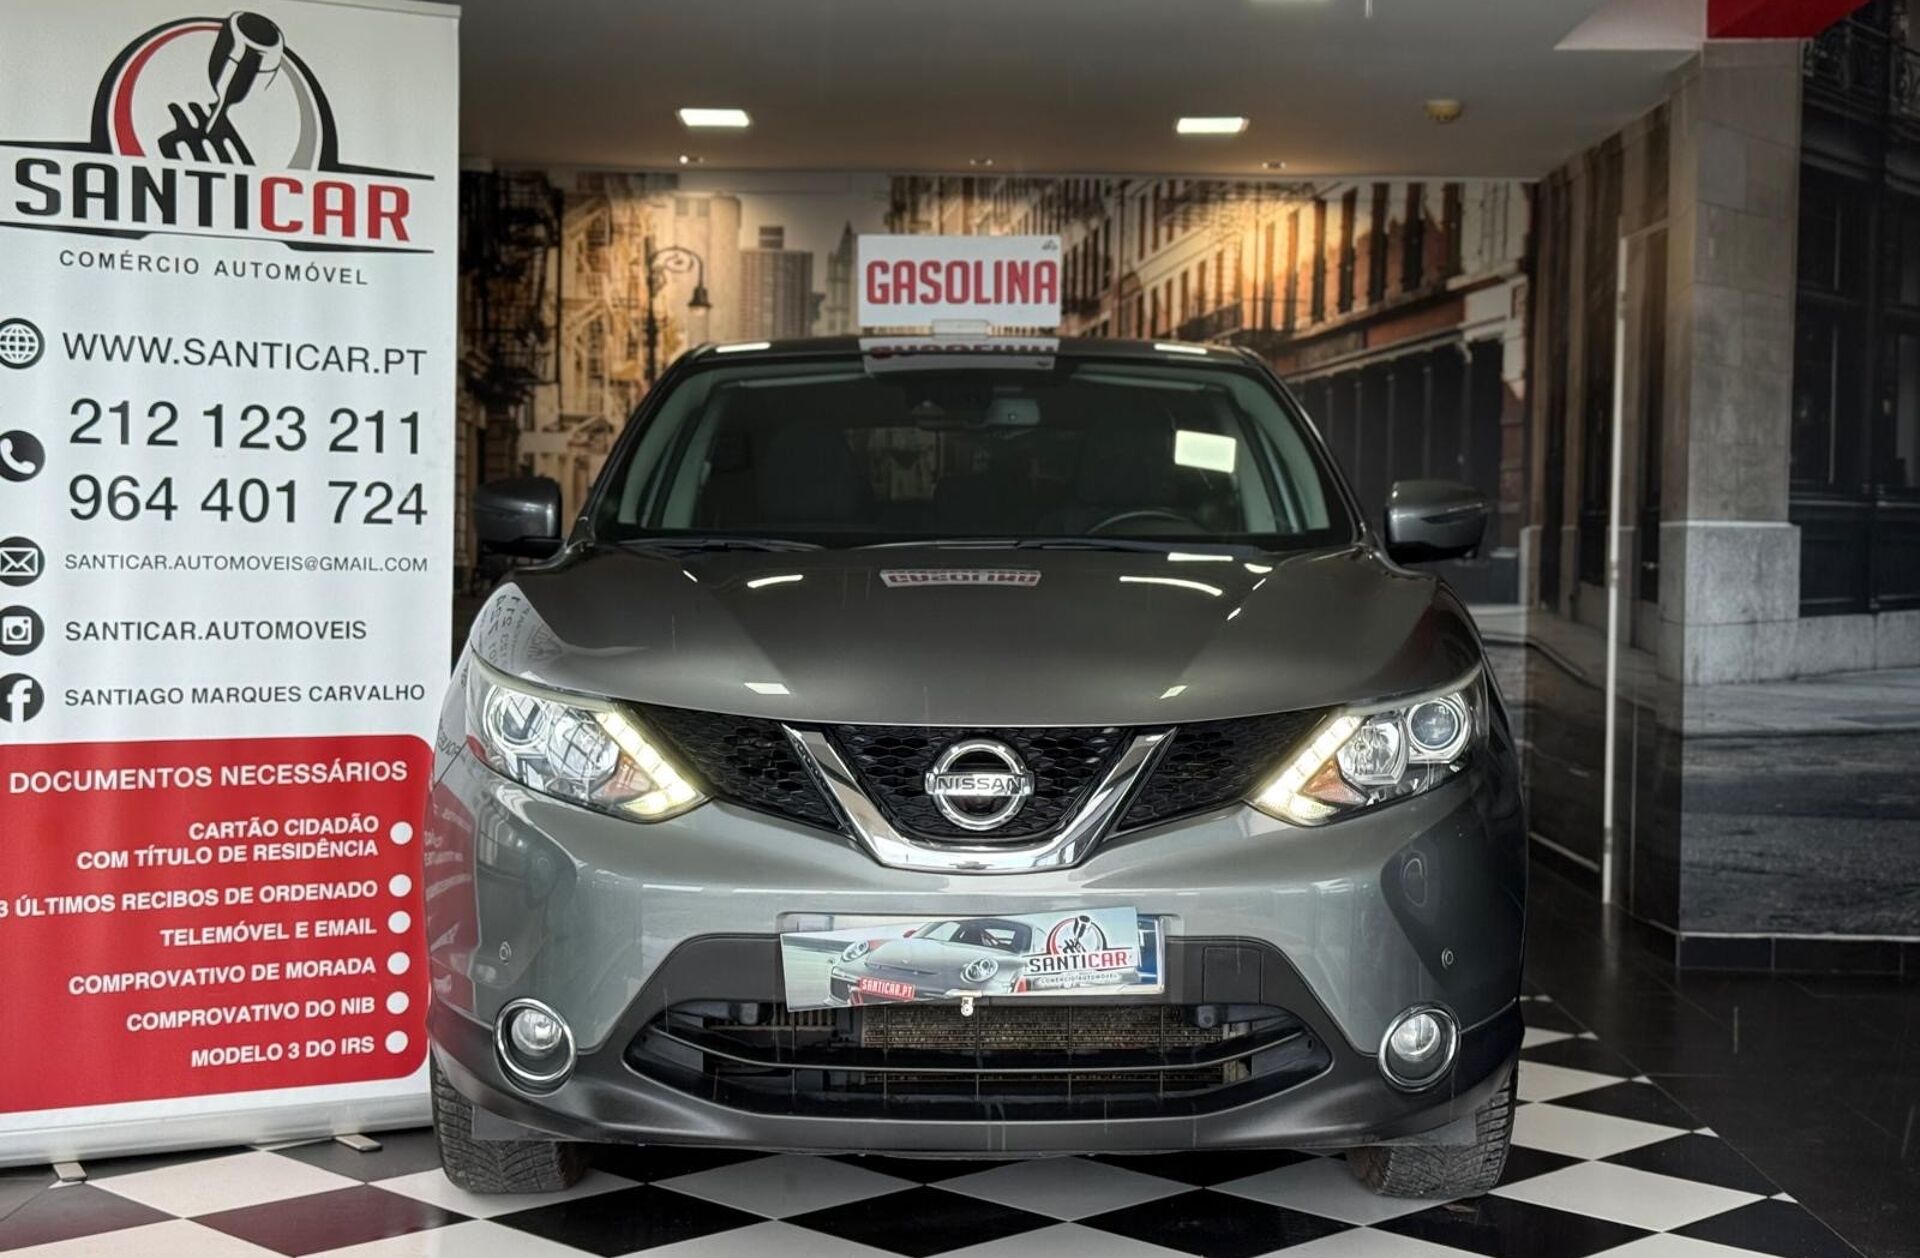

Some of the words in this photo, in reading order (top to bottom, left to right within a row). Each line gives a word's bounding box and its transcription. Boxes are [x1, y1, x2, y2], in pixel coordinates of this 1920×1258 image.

[15, 157, 410, 241] SANTICAR
[60, 250, 199, 274] COMÉRCIO
[214, 260, 367, 285] AUTOMÓVEL
[866, 260, 1057, 305] GASOLINA
[63, 333, 427, 375] WWW.SANTICAR.PT
[70, 398, 177, 446] 212
[204, 404, 306, 451] 123
[329, 408, 418, 454] 211
[70, 474, 178, 520] 964
[201, 478, 295, 523] 401
[329, 481, 427, 525] 724
[65, 554, 427, 571] SANTICAR.AUTOMOVEIS@GMAIL.COM
[66, 621, 366, 641] SANTICAR.AUTOMOVEIS
[65, 688, 183, 706] SANTIAGO
[192, 686, 301, 703] MARQUES
[309, 685, 424, 701] CARVALHO
[10, 767, 212, 793] DOCUMENTOS
[221, 759, 407, 785] NECESSÁRIOS
[938, 776, 1020, 791] NISSAN
[189, 817, 278, 840] CARTÃO
[285, 814, 378, 836] CIDADÃO
[77, 851, 128, 869] COM
[134, 845, 212, 866] TÍTULO
[219, 845, 246, 862] DE
[254, 838, 378, 860] RESIDÊNCIA
[16, 894, 115, 916] ÚLTIMOS
[122, 889, 218, 910] RECIBOS
[225, 887, 253, 904] DE
[259, 881, 377, 902] ORDENADO
[160, 921, 289, 946] TELEMÓVEL
[296, 922, 308, 938] E
[315, 918, 376, 937] EMAIL
[69, 966, 245, 994] COMPROVATIVO
[252, 963, 279, 981] DE
[286, 958, 376, 978] MORADA
[1029, 951, 1128, 973] SANTICAR
[862, 979, 913, 999] SANTICAR.PT
[127, 1002, 299, 1031] COMPROVATIVO
[306, 1000, 335, 1017] DO
[342, 997, 374, 1014] NIB
[192, 1044, 282, 1067] MODELO
[288, 1043, 299, 1059] 3
[306, 1039, 336, 1057] DO
[342, 1036, 374, 1054] IRS
